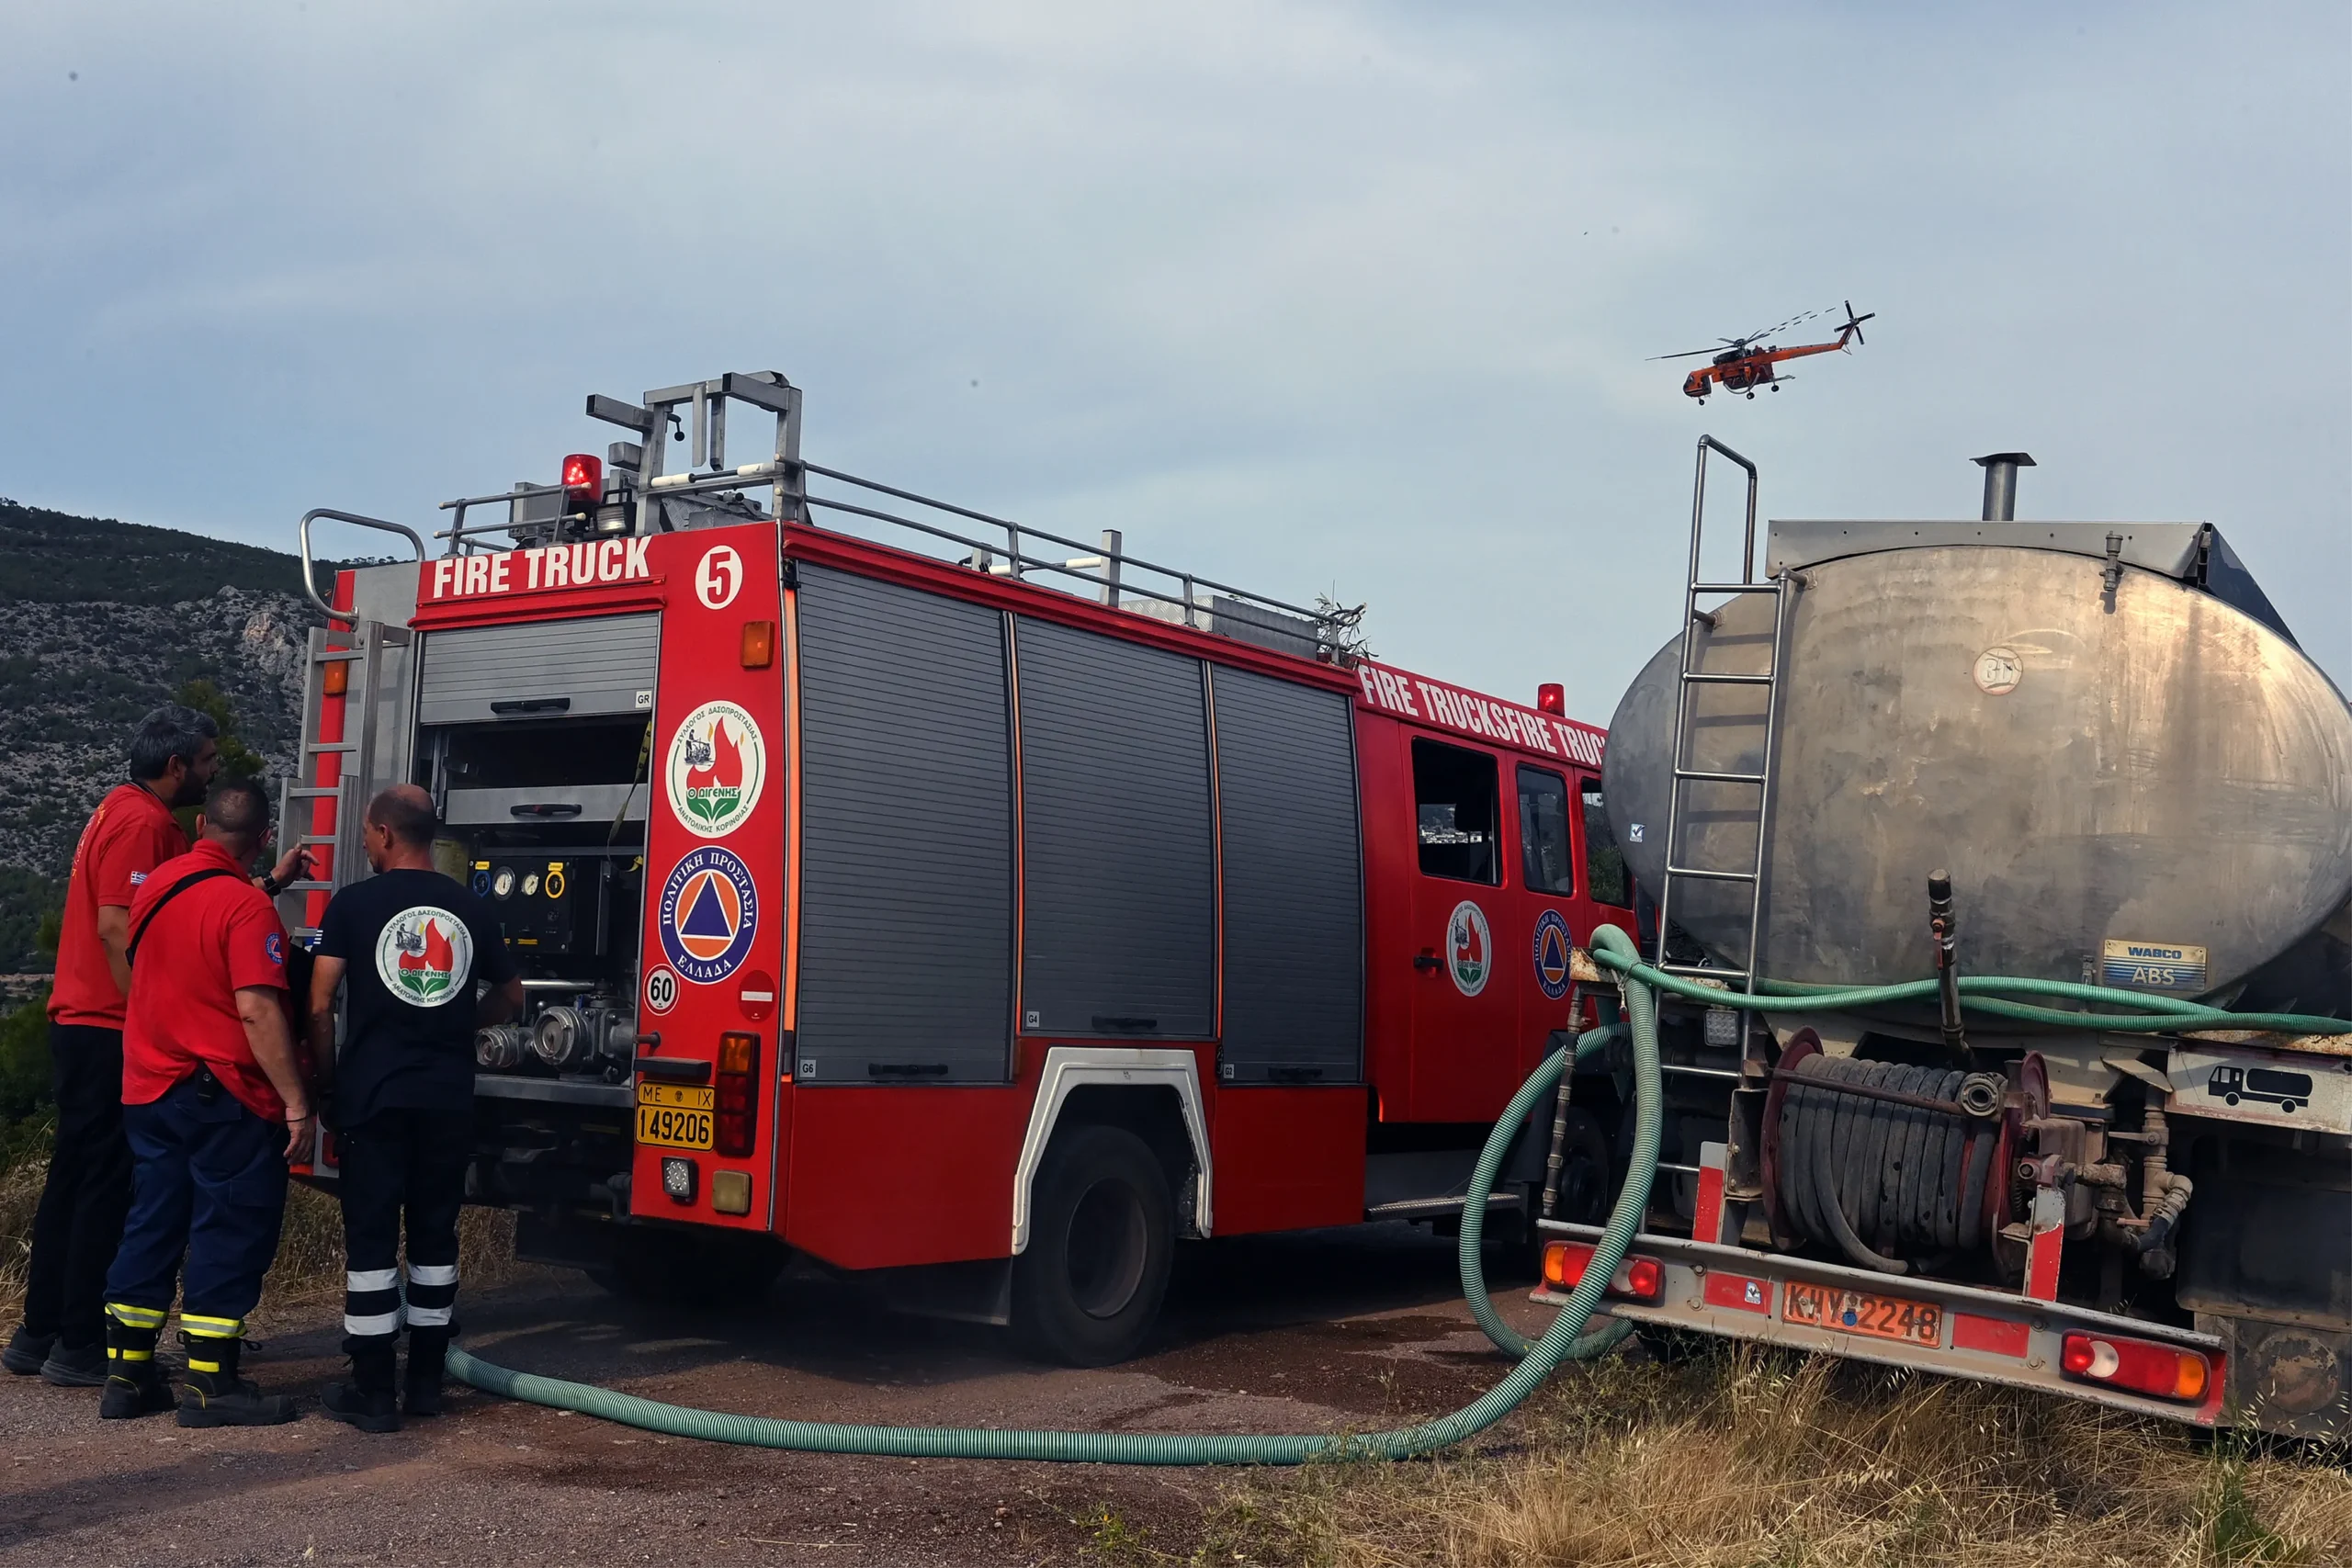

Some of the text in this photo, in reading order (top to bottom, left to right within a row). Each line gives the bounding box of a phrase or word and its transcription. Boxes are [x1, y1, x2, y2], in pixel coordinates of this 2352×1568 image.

[433, 536, 652, 598] FIRE TRUCK
[706, 551, 732, 604] 5
[1358, 664, 1419, 717] FIRE
[1552, 721, 1606, 766] TRUC
[663, 852, 753, 929] ΠΟΛΙΤΙΚΗ ΠΡΟΣΤΑΣΙΑ
[677, 954, 732, 978] ΕΛΛΑΔΑ
[2128, 946, 2182, 960] WABCO
[650, 976, 673, 1002] 60
[2132, 965, 2176, 986] ABS
[803, 1064, 814, 1073] G6
[640, 1109, 710, 1145] 149206
[1857, 1295, 1938, 1341] 2248
